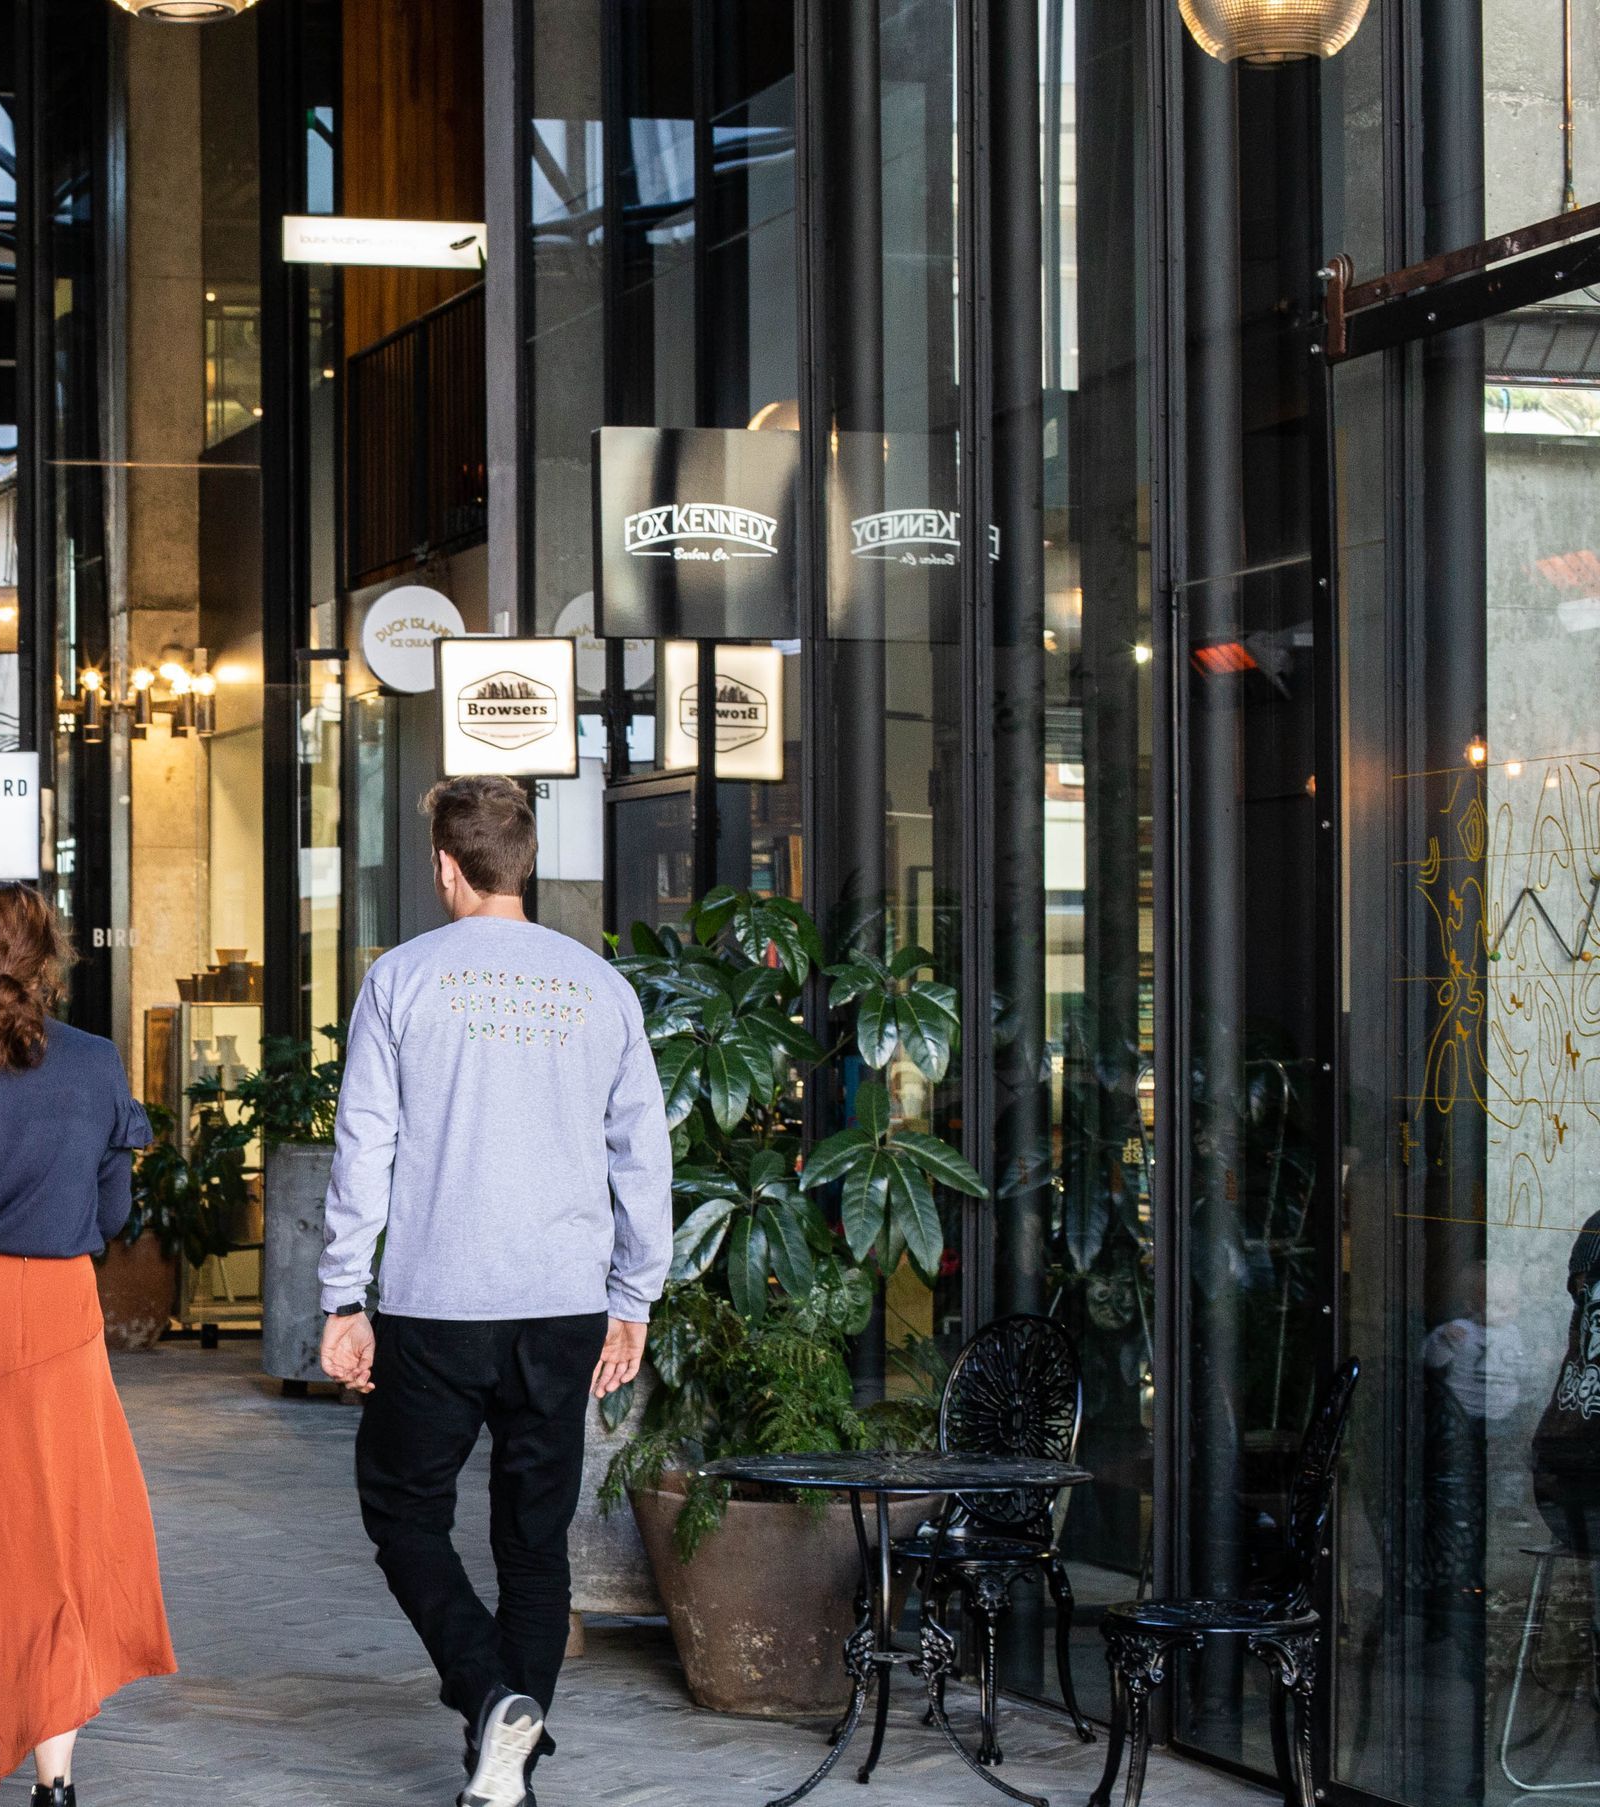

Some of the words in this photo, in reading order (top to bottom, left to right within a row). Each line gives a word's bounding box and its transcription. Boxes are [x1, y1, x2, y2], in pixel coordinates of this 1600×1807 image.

[624, 511, 669, 546] FOX
[672, 503, 778, 546] KENNEDY
[673, 547, 710, 560] Barbers
[712, 547, 730, 562] Co.
[375, 618, 409, 643] DUCK
[467, 703, 548, 716] Browsers
[92, 927, 141, 948] BIRD
[450, 993, 586, 1025] OUTDOORS
[468, 1021, 569, 1047] SOCIETY
